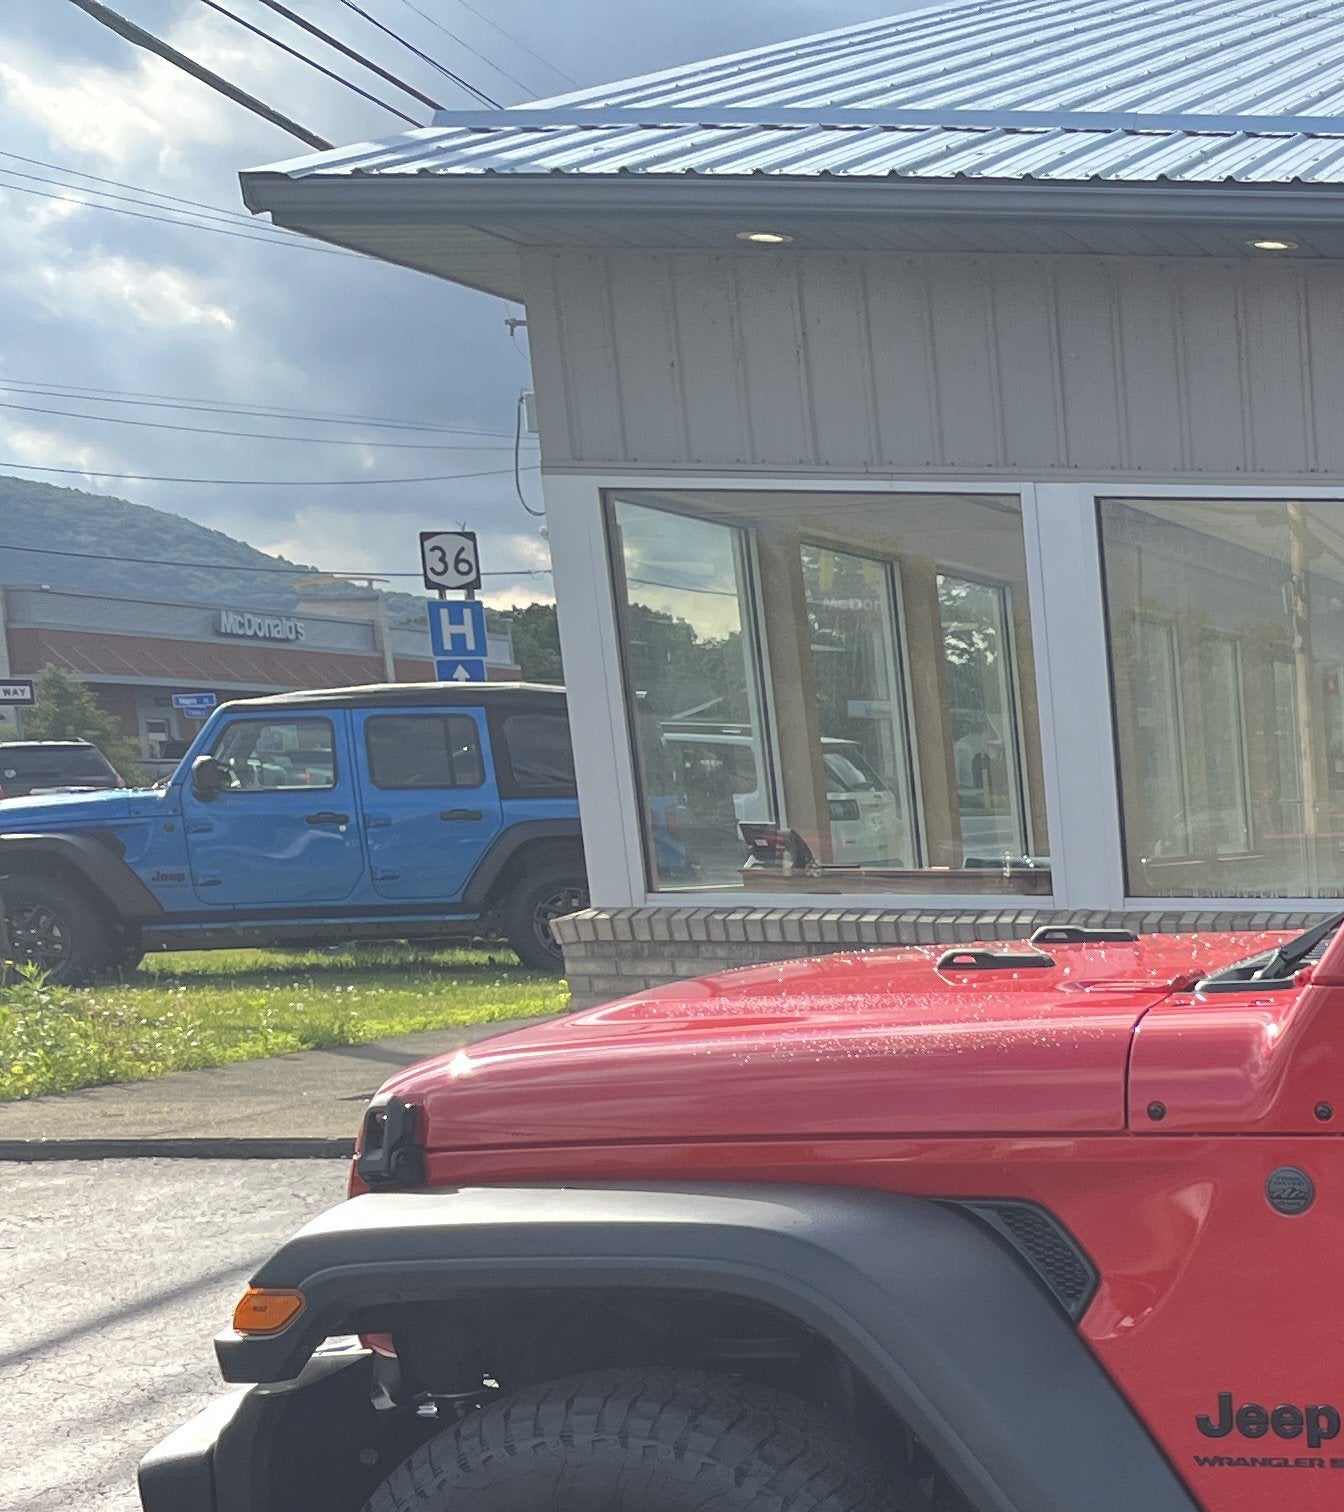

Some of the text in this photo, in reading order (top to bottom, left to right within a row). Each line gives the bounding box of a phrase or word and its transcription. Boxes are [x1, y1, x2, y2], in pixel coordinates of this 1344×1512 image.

[429, 545, 474, 576] 36
[220, 610, 306, 641] McDonald's
[439, 607, 476, 651] H
[3, 687, 27, 697] WAY
[1196, 1391, 1341, 1448] Jeep
[1193, 1455, 1325, 1469] WRANGLER
